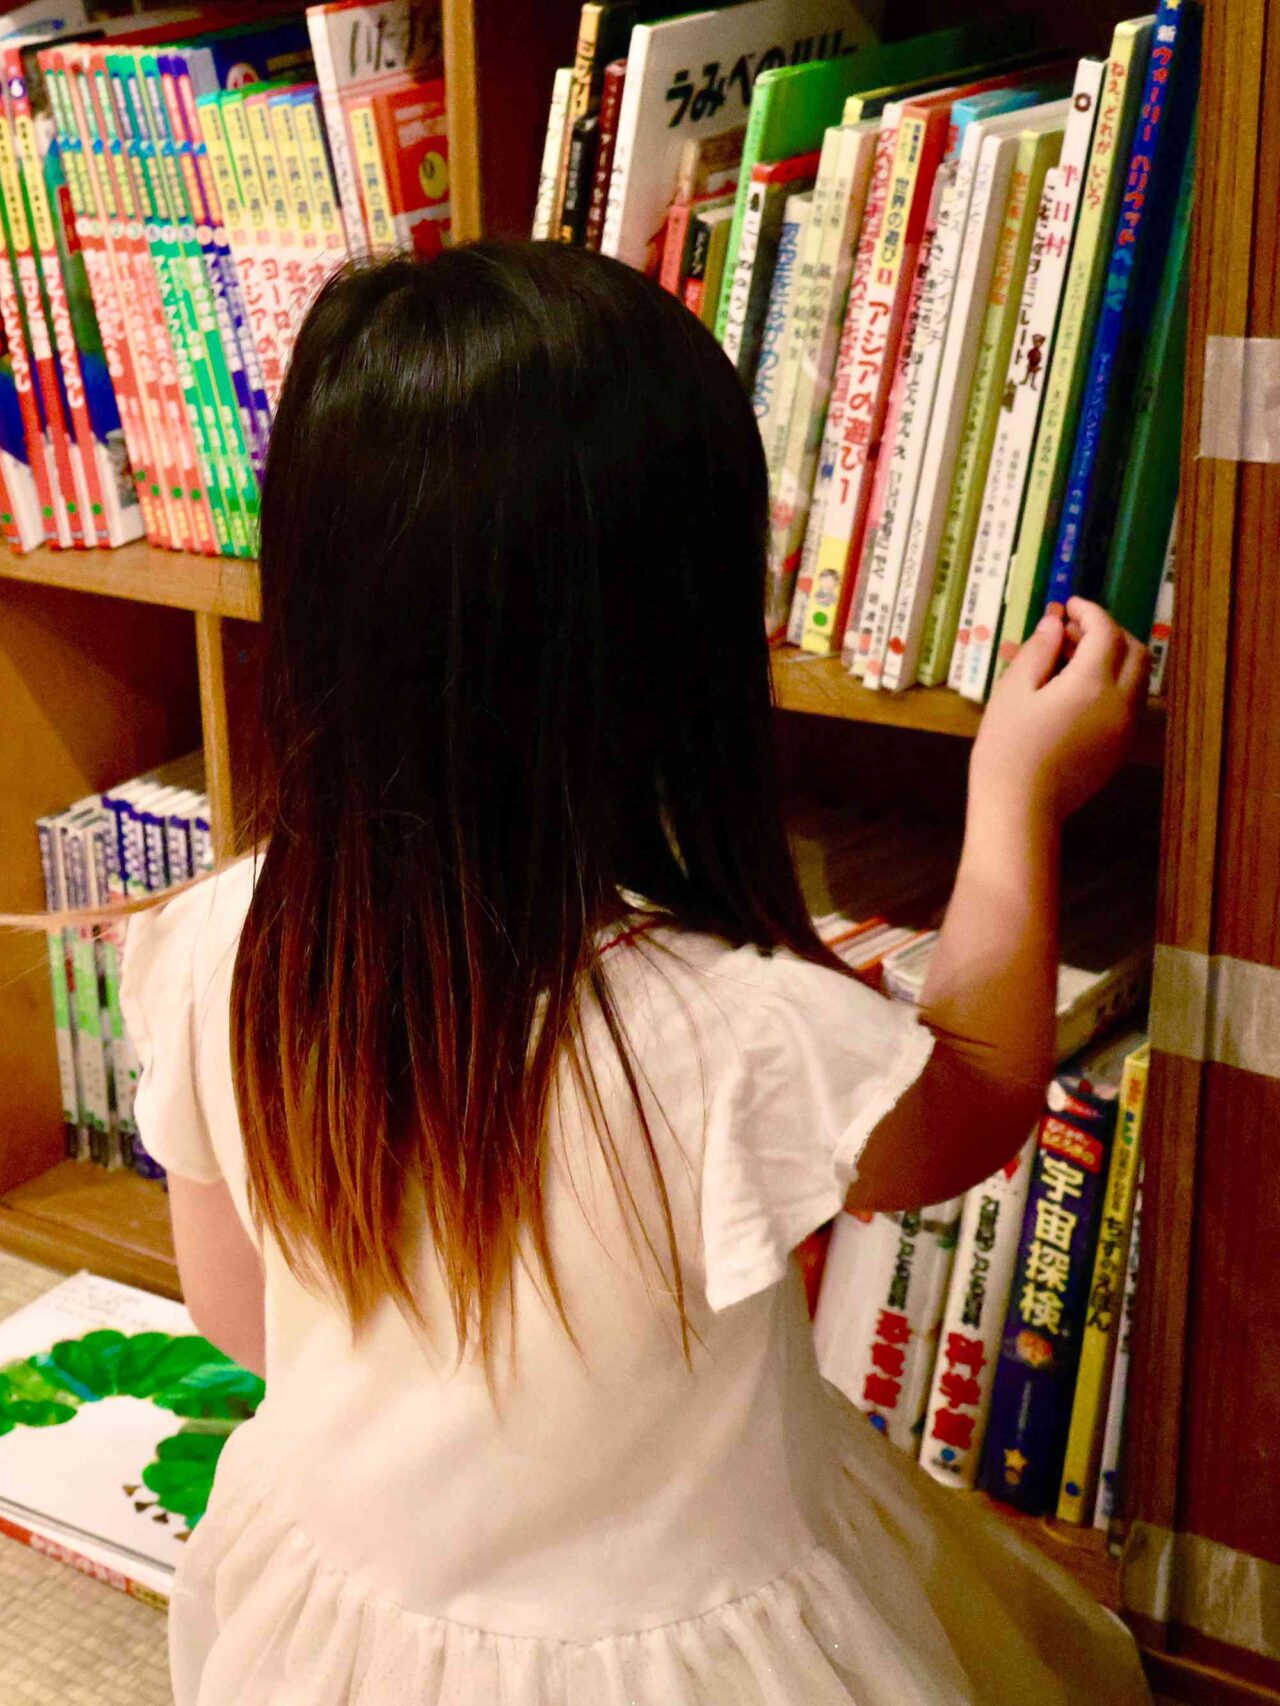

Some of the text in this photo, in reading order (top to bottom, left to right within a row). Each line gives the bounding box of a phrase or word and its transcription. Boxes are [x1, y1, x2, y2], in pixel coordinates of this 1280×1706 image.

[1045, 162, 1080, 259] 半日村
[1020, 1155, 1089, 1333] 宇宙探検
